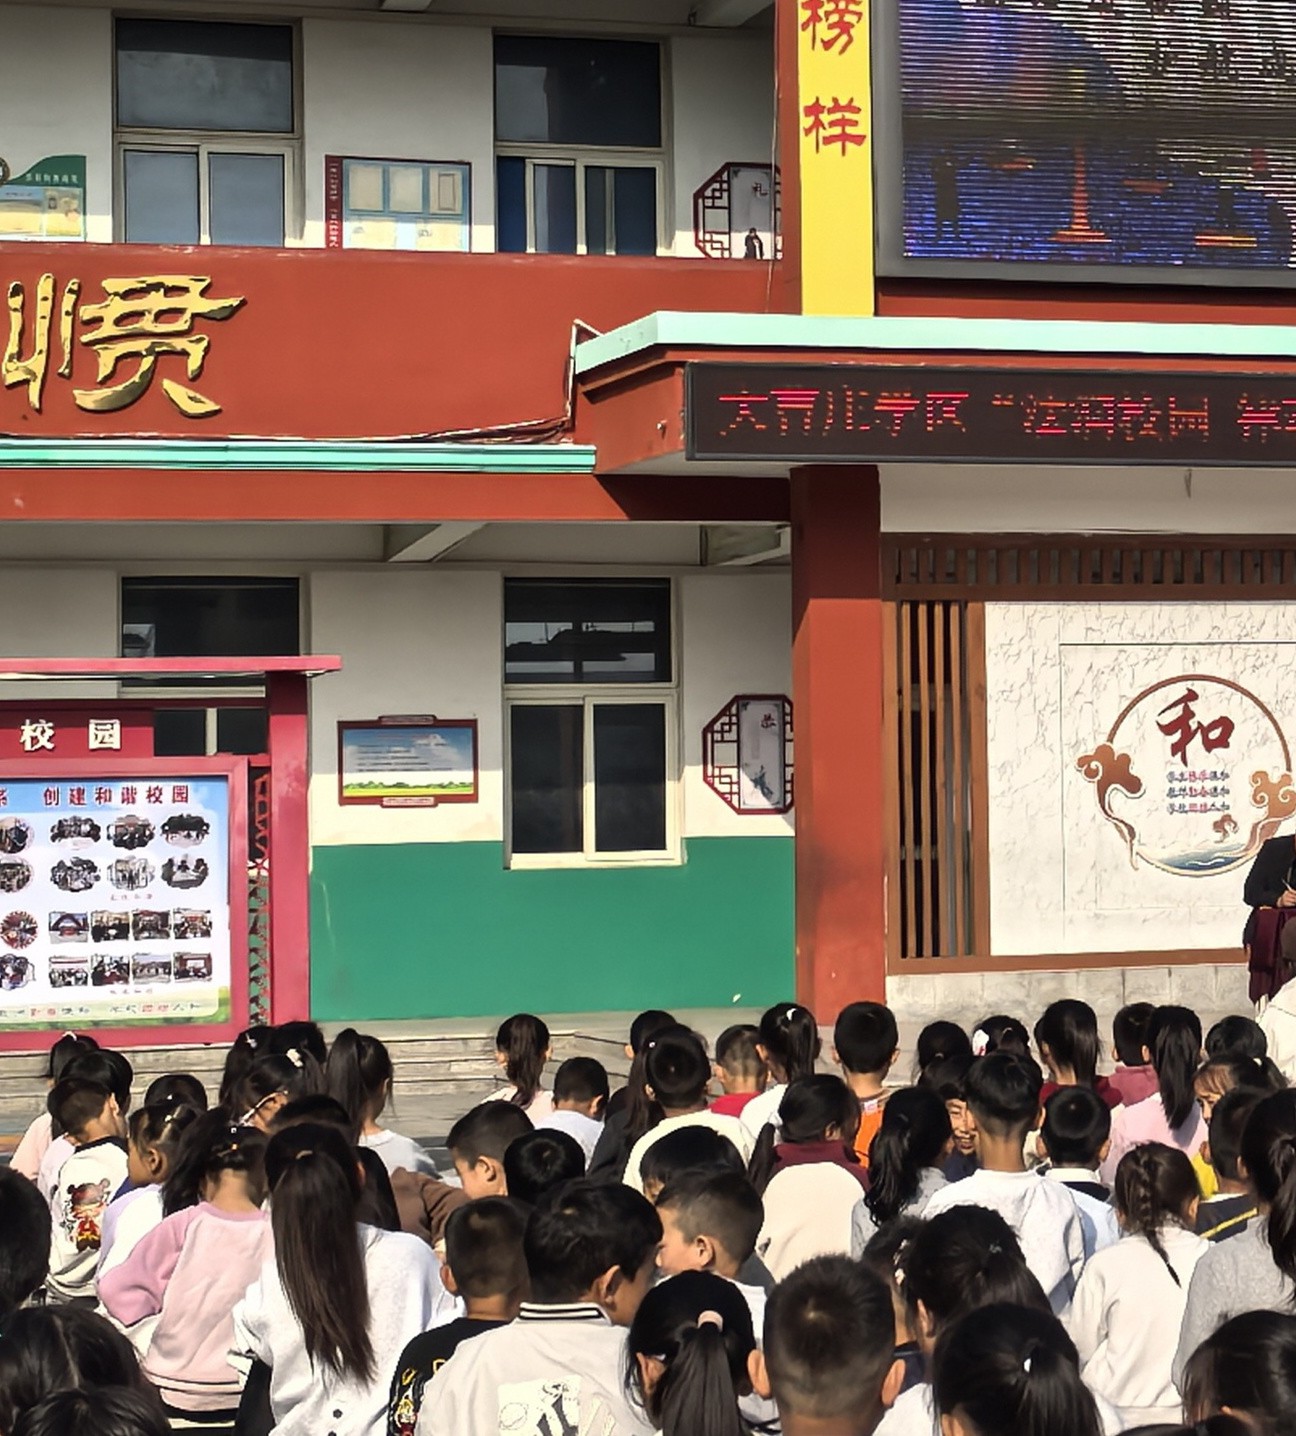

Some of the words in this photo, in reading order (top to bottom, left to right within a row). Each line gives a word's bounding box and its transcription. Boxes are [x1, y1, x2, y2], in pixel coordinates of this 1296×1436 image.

[801, 0, 867, 157] 榜样
[2, 273, 246, 418] 惯
[19, 718, 122, 752] 校园
[1155, 687, 1235, 768] 和
[43, 784, 190, 806] 创建和谐校园
